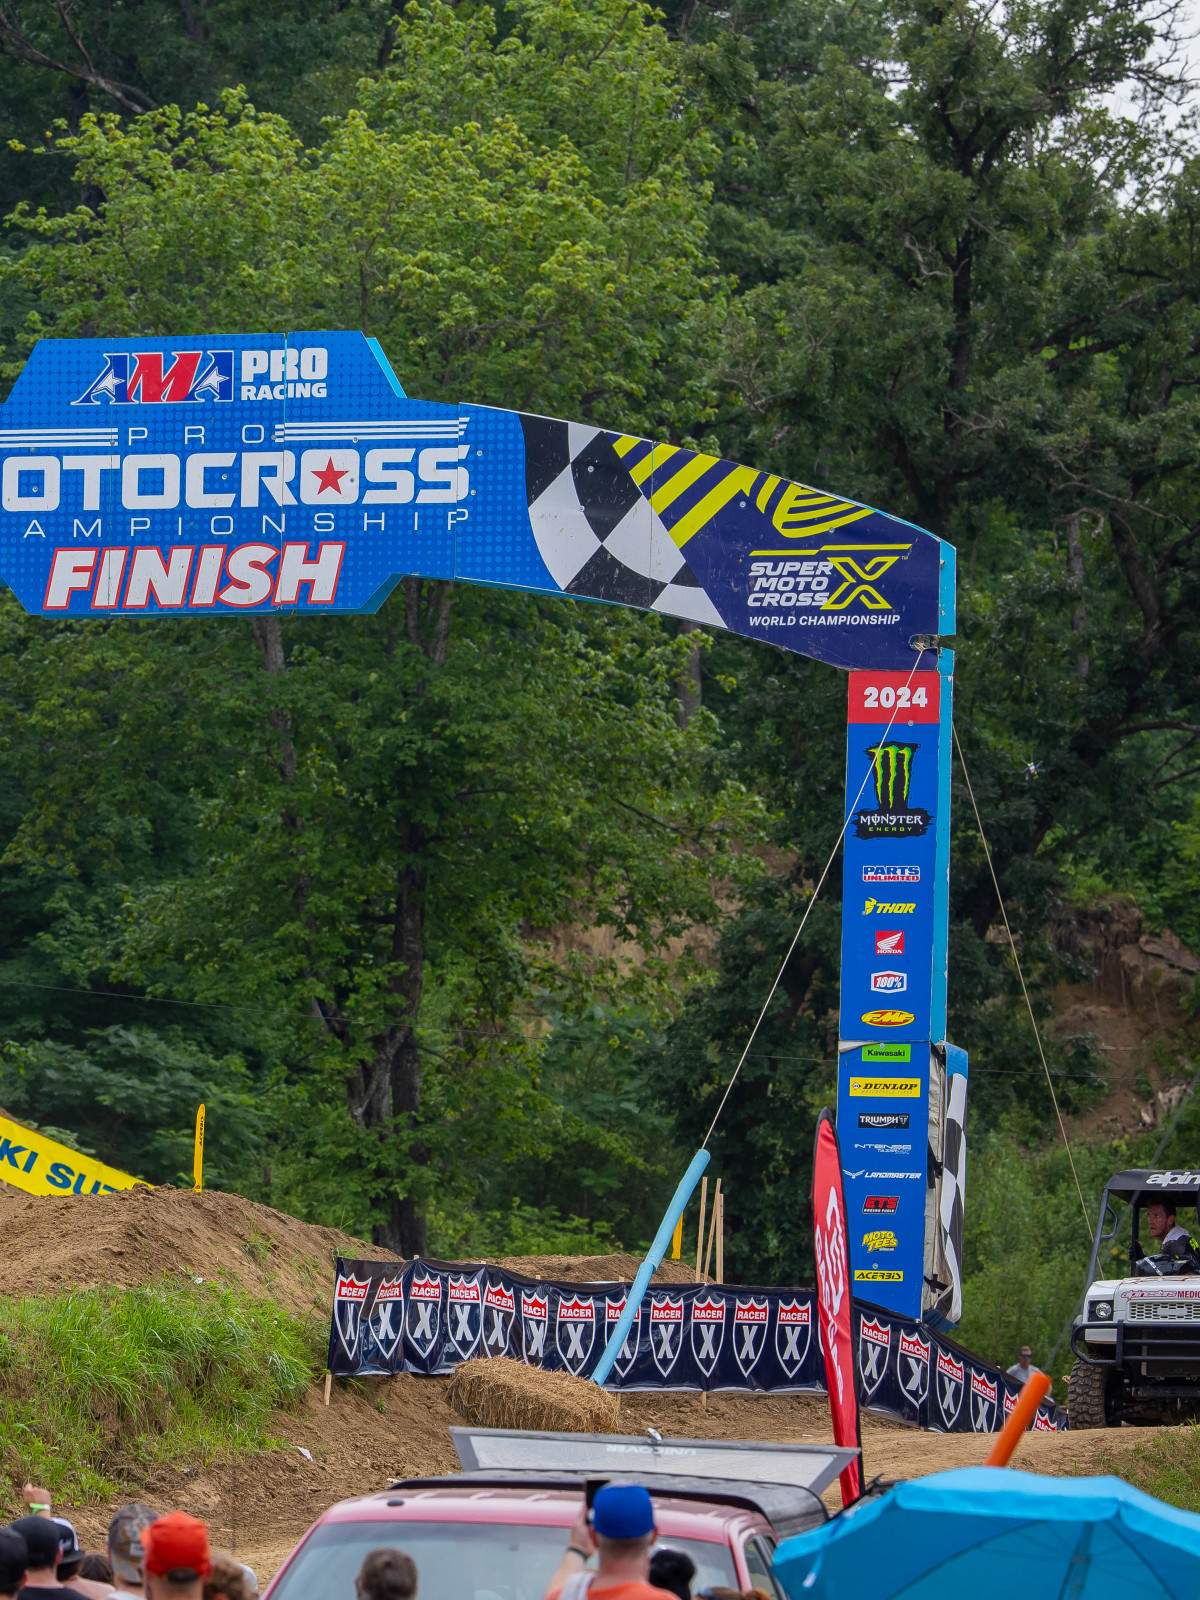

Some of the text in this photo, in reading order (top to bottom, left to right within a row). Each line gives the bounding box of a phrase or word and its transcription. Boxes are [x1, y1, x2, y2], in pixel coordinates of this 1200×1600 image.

[241, 348, 328, 383] PRO
[71, 350, 234, 405] AMA
[241, 382, 327, 401] RACING
[128, 424, 265, 446] PRO
[42, 541, 347, 611] FINISH
[748, 561, 834, 577] SUPER
[753, 576, 829, 592] MOTO
[747, 592, 830, 607] CROSS
[749, 614, 901, 627] WORLD CHAMPIONSHIP
[863, 686, 929, 708] 2024
[860, 813, 923, 826] MONSTER
[863, 865, 920, 876] PARTS
[876, 903, 916, 914] THOR
[875, 976, 902, 988] 100%
[867, 1049, 905, 1057] Kawasaki
[860, 1115, 898, 1125] TRIUMPH
[865, 1196, 899, 1209] ETS
[863, 1231, 895, 1246] MOTO
[866, 1238, 898, 1253] TEES
[856, 1272, 902, 1282] ACERBIS
[411, 1286, 440, 1297] RACER
[450, 1288, 478, 1299] RACER
[378, 1302, 396, 1340] X
[412, 1302, 433, 1340] X
[560, 1308, 592, 1318] RACER
[653, 1309, 682, 1319] RACER
[694, 1309, 723, 1319] RACER
[738, 1311, 766, 1321] RACER
[780, 1312, 808, 1322] RACER
[454, 1304, 474, 1341] X
[487, 1309, 505, 1348] X
[527, 1320, 545, 1358] X
[566, 1323, 585, 1359] X
[657, 1324, 676, 1359] X
[698, 1324, 716, 1359] X
[740, 1326, 758, 1360] X
[783, 1327, 801, 1360] X
[863, 1326, 889, 1344] RACER
[902, 1341, 928, 1358] RACER
[864, 1343, 881, 1380] X
[940, 1360, 962, 1379] RACER
[905, 1357, 923, 1396] X
[942, 1376, 957, 1415] X
[973, 1379, 995, 1399] RACER
[975, 1395, 990, 1433] X
